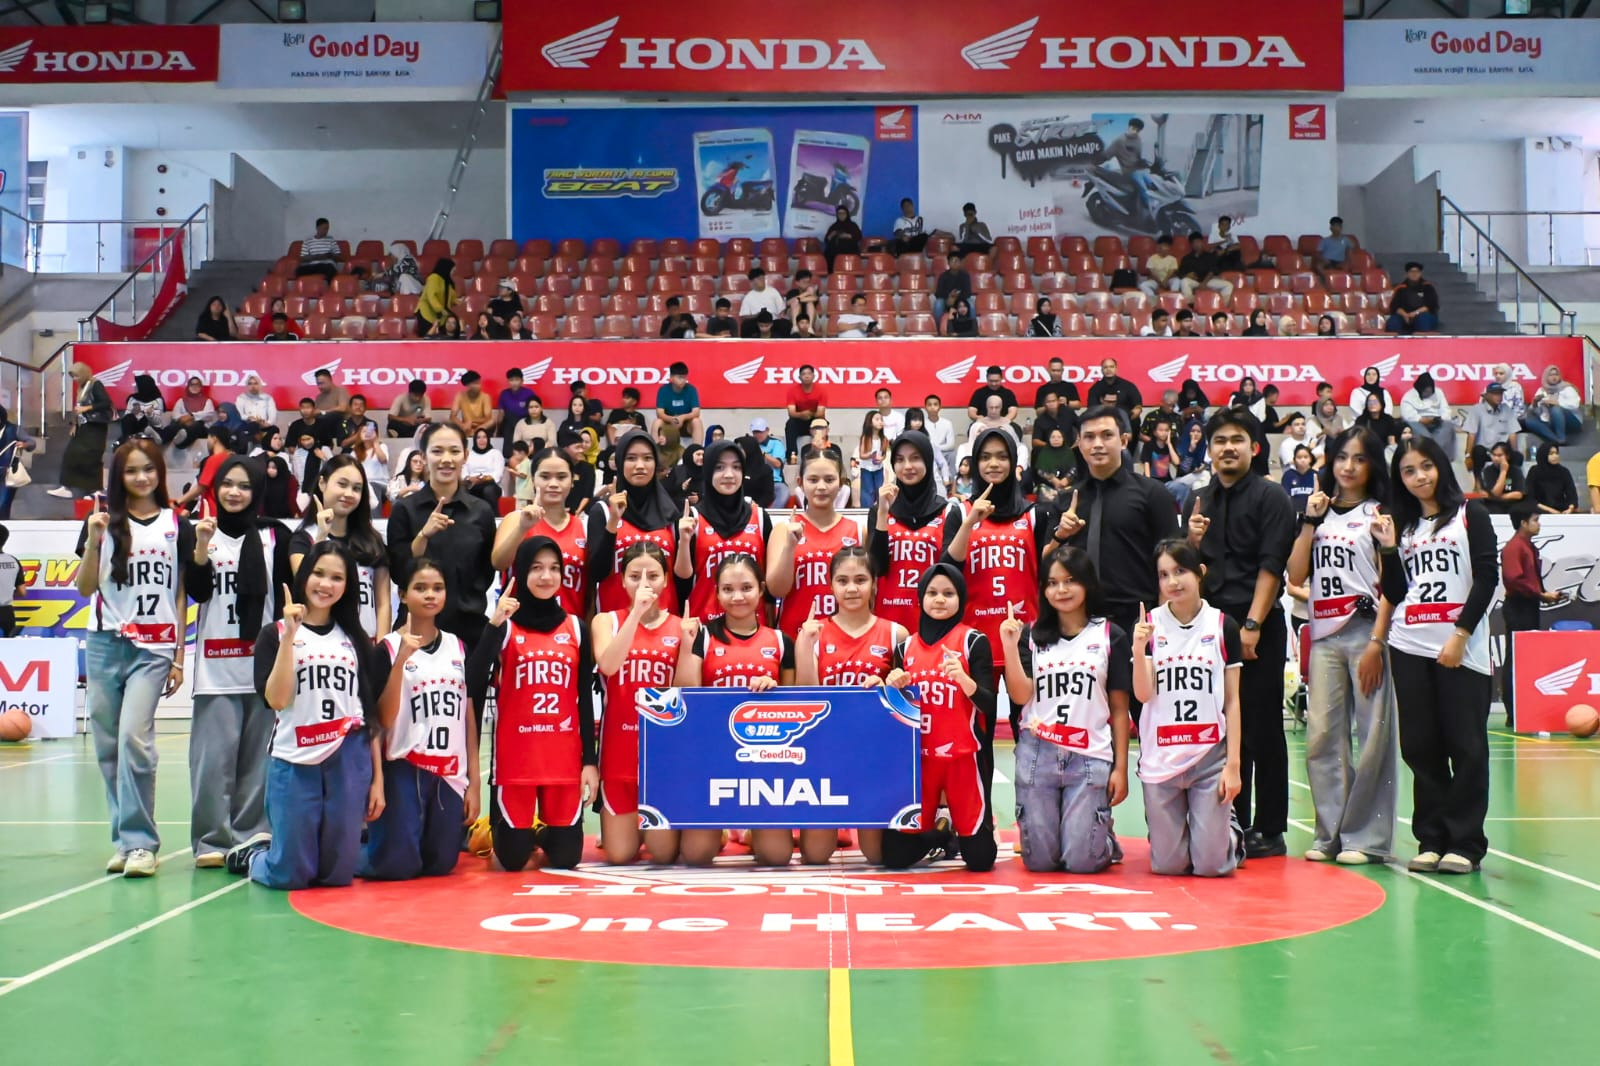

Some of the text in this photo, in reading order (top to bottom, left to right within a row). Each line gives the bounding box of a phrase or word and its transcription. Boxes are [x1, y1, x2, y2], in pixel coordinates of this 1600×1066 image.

[309, 34, 369, 58] Good
[374, 34, 419, 62] Day
[620, 38, 886, 70] HONDA
[1040, 36, 1306, 69] HONDA
[1430, 31, 1491, 54] Good
[1495, 30, 1542, 59] Day
[33, 50, 195, 71] HONDA
[1016, 149, 1036, 162] GAYA
[1037, 146, 1064, 159] MAKIN
[1188, 364, 1326, 382] HONDA
[970, 545, 1026, 574] FIRST
[1315, 545, 1356, 572] IRST
[1404, 548, 1460, 582] FIRST
[796, 561, 828, 590] FIR
[898, 568, 920, 588] 12
[992, 576, 1006, 597] 5
[1320, 576, 1345, 597] 99
[1418, 581, 1448, 602] 22
[136, 594, 160, 616] 17
[814, 594, 836, 615] 18
[296, 664, 355, 695] FIRST
[515, 660, 571, 690] FIRST
[619, 659, 674, 688] FIRST
[1156, 666, 1213, 696] FIRST
[918, 680, 958, 709] RST
[1036, 671, 1097, 703] FIRST
[322, 699, 335, 720] 9
[410, 690, 463, 724] FIRST
[533, 693, 560, 714] 22
[1056, 704, 1070, 725] 5
[1174, 700, 1198, 722] 12
[757, 711, 807, 719] HONDA
[300, 736, 315, 745] One
[427, 726, 450, 750] 10
[756, 724, 782, 737] DBL
[1158, 736, 1171, 745] One
[709, 778, 849, 806] FINAL
[513, 883, 1153, 896] HONDA
[480, 911, 1198, 932] One HEART.
